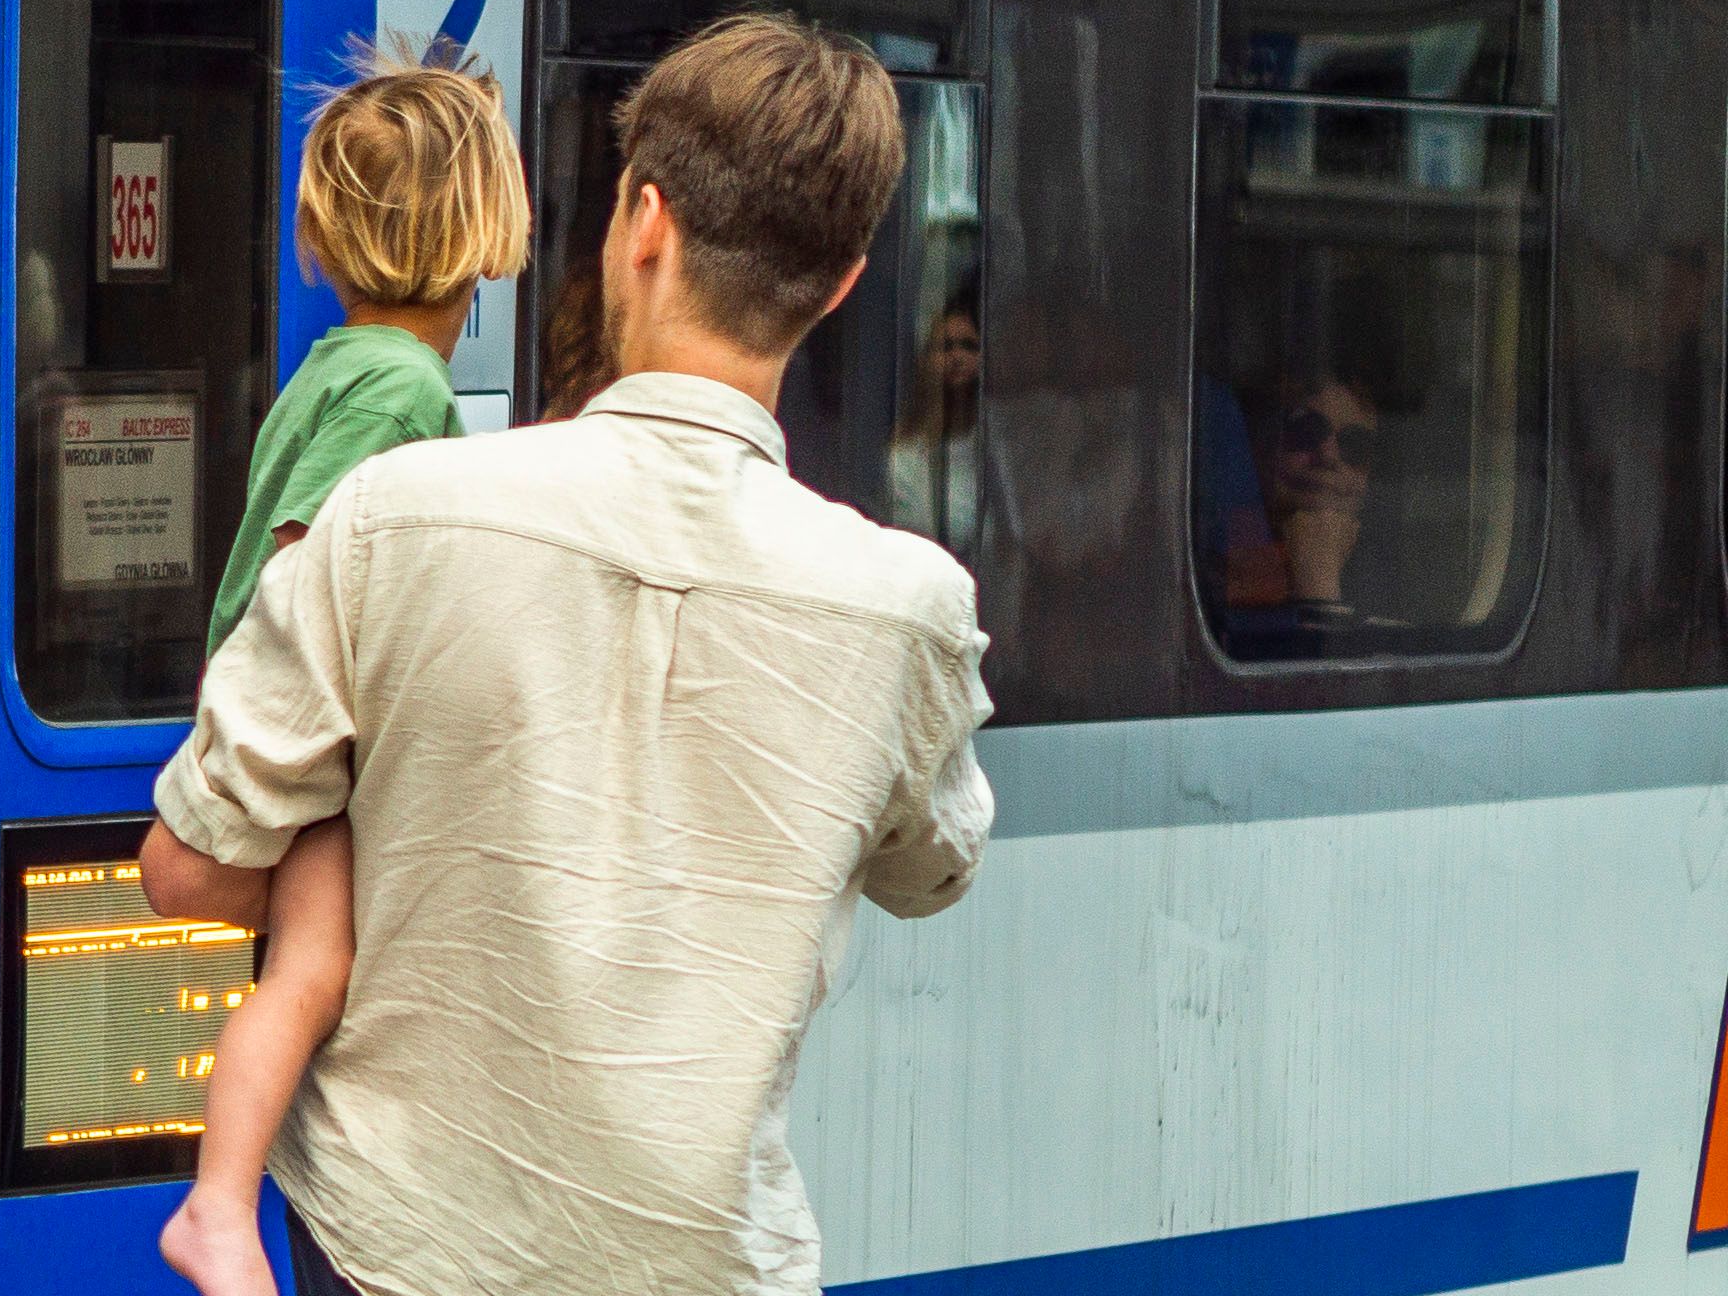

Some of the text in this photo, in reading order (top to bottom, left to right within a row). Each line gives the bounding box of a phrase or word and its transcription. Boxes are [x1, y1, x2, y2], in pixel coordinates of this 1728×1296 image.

[111, 175, 157, 260] 365
[122, 417, 152, 436] BALTIC
[153, 416, 191, 435] EXPRESS
